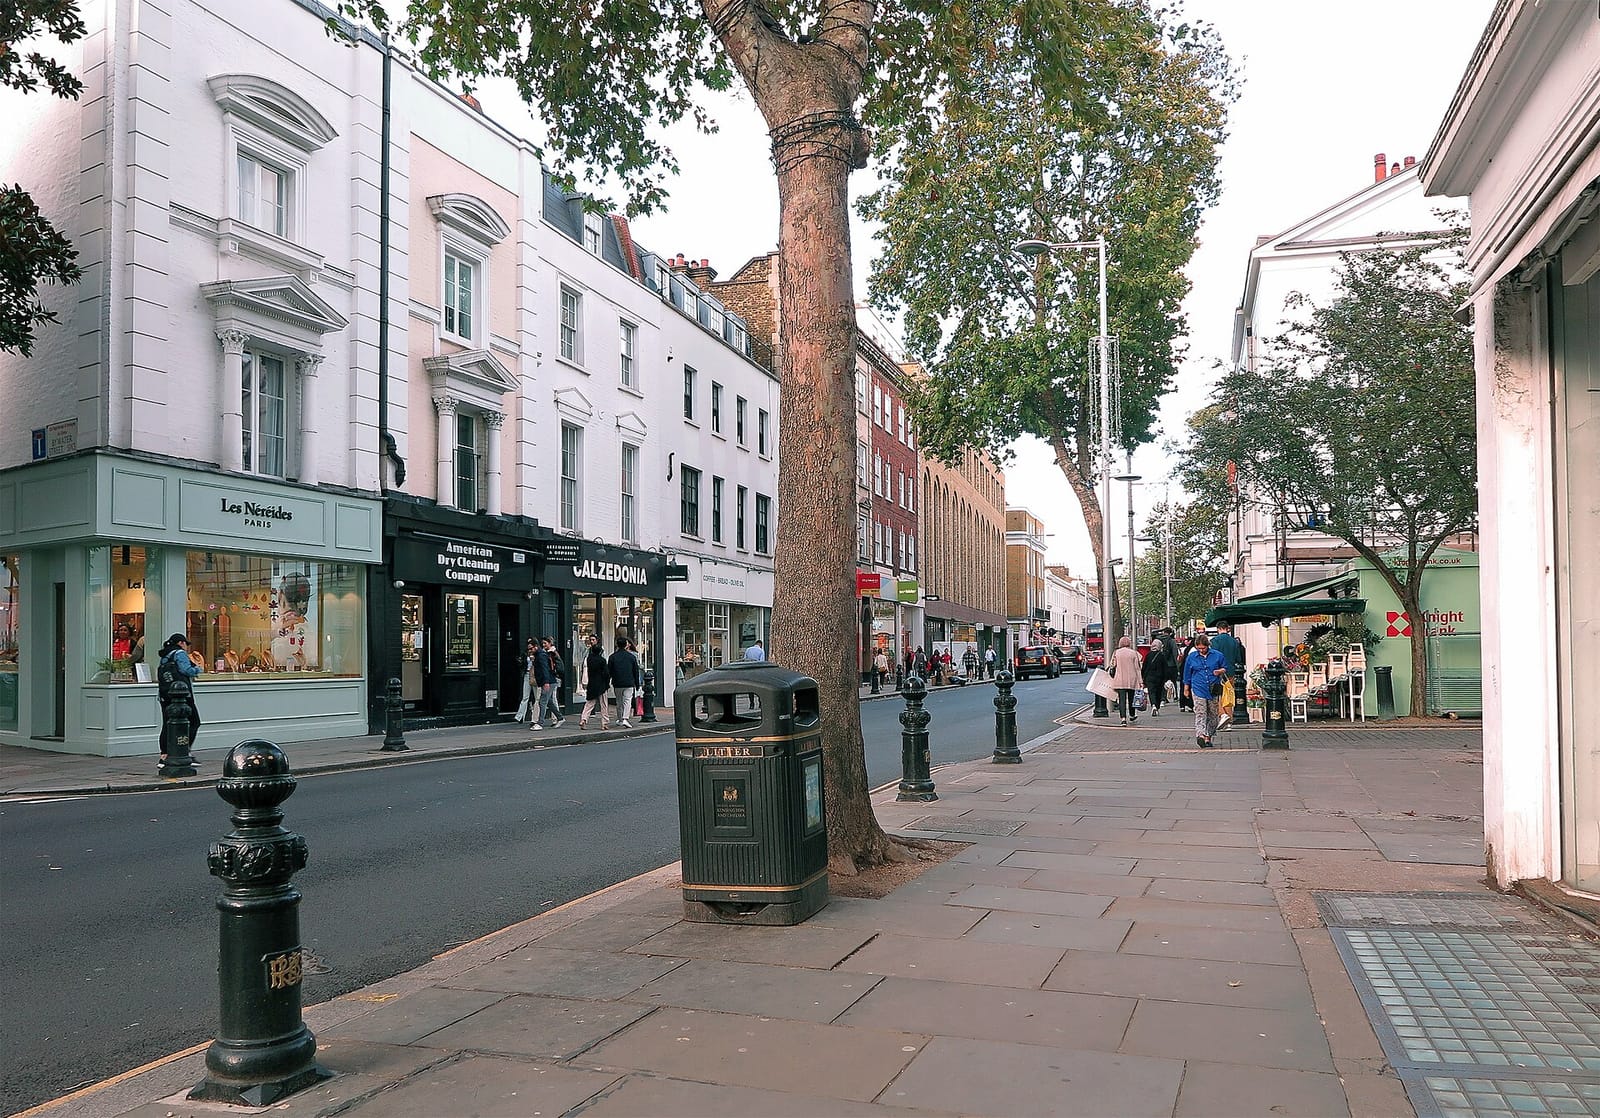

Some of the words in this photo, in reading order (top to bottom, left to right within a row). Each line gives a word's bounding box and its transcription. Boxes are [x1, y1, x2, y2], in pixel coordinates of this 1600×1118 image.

[221, 498, 242, 513] Les
[244, 502, 292, 520] Néréides
[244, 519, 272, 528] PARIS
[446, 542, 493, 557] American
[438, 554, 457, 567] Dry
[457, 557, 500, 572] Cleaning
[445, 569, 492, 584] Company
[573, 560, 648, 585] CALZEDONIA
